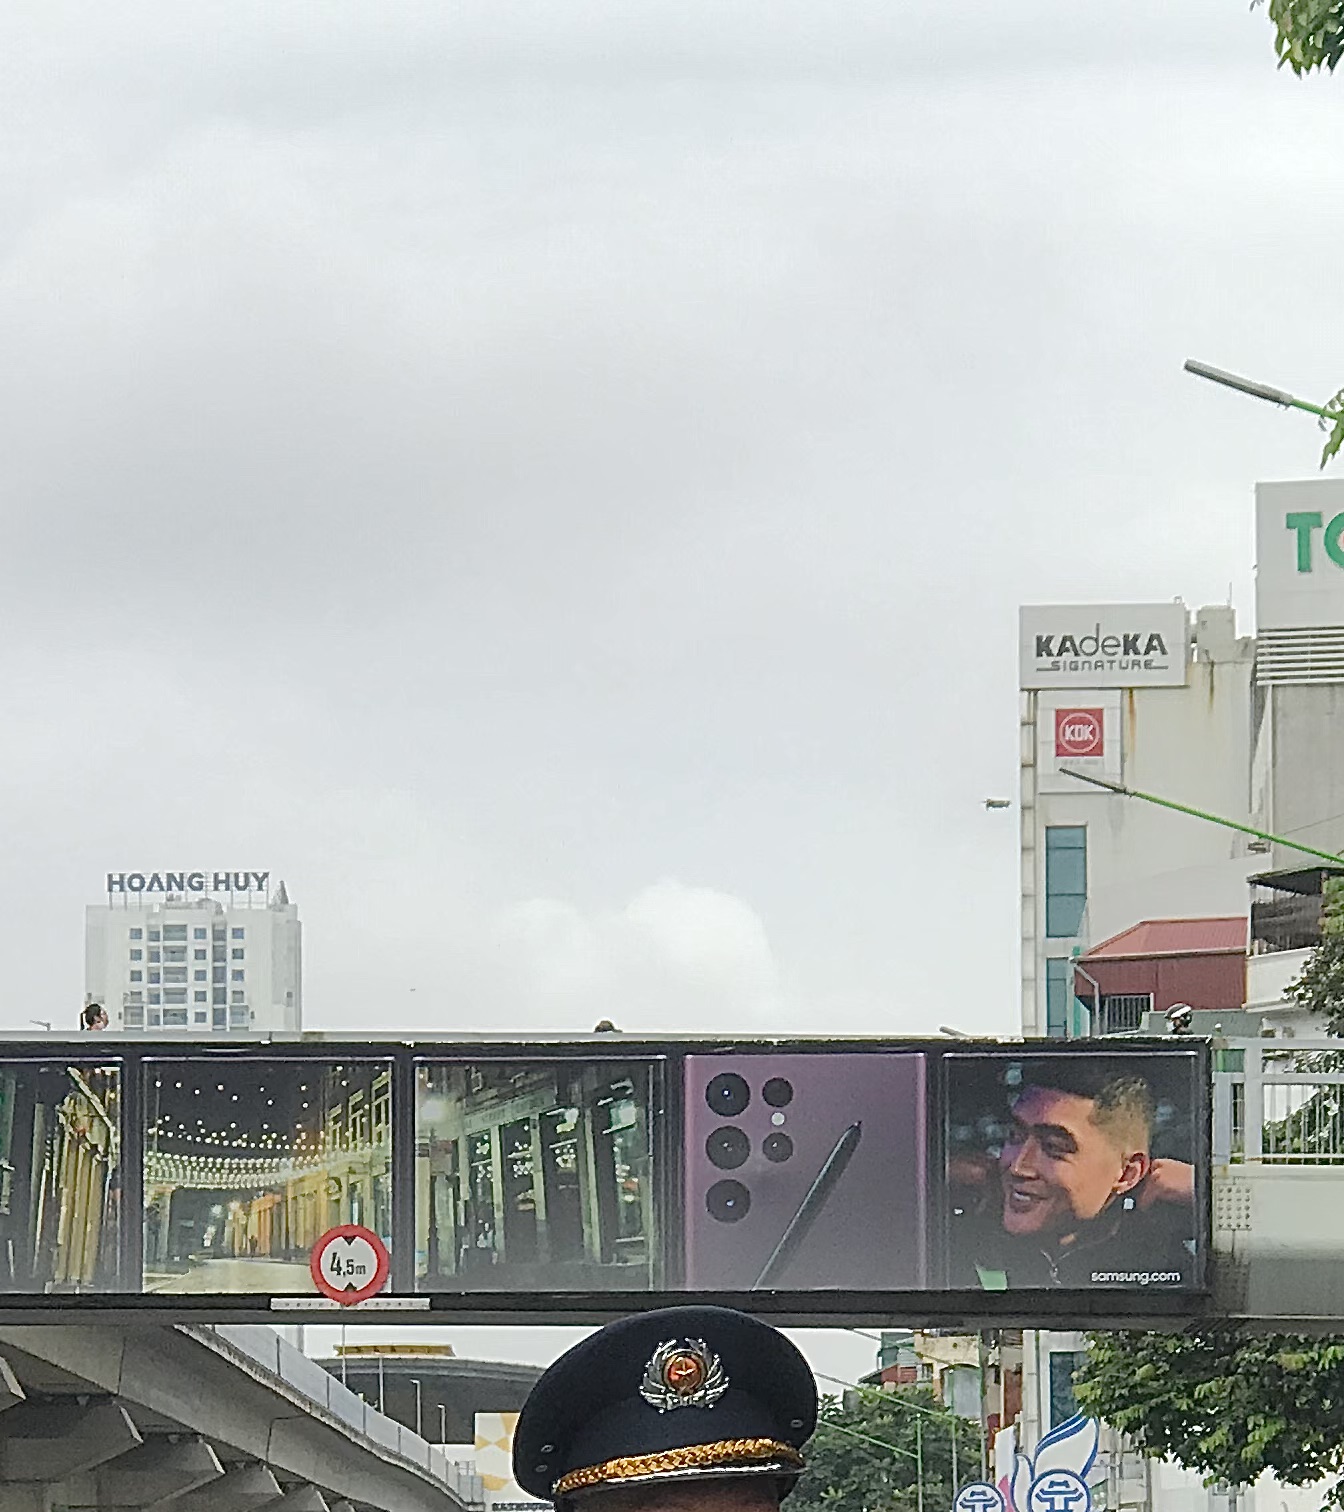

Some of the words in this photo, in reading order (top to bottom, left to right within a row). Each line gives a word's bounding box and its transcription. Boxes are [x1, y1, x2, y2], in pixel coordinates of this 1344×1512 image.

[1036, 623, 1168, 657] KAdeKA
[1049, 659, 1156, 672] SIGNATURE
[107, 872, 205, 892] HOANG
[213, 872, 269, 892] HUY
[1091, 1272, 1181, 1285] samsung.com
